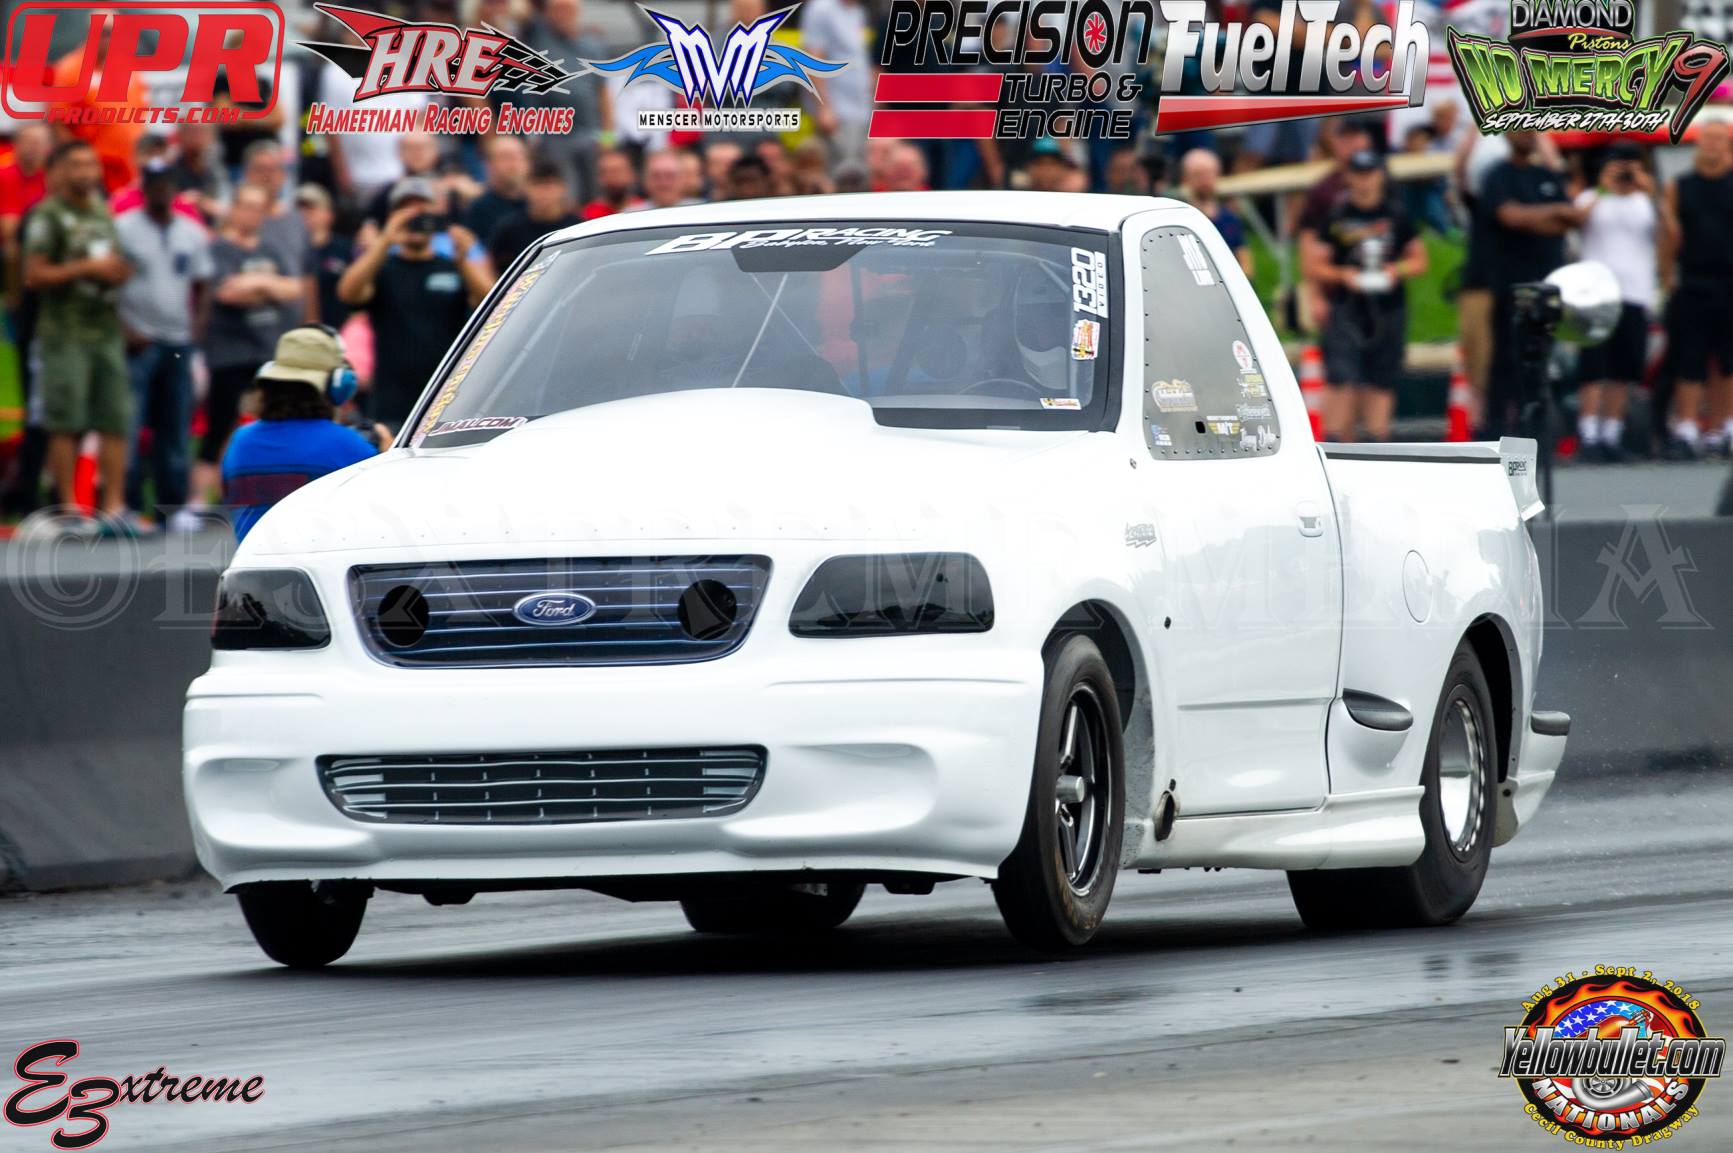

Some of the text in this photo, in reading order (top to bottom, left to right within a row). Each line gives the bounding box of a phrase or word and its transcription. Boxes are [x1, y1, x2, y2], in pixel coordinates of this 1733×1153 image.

[646, 227, 952, 256] BP RACING
[1071, 247, 1098, 315] 1320
[532, 599, 576, 617] Ford
